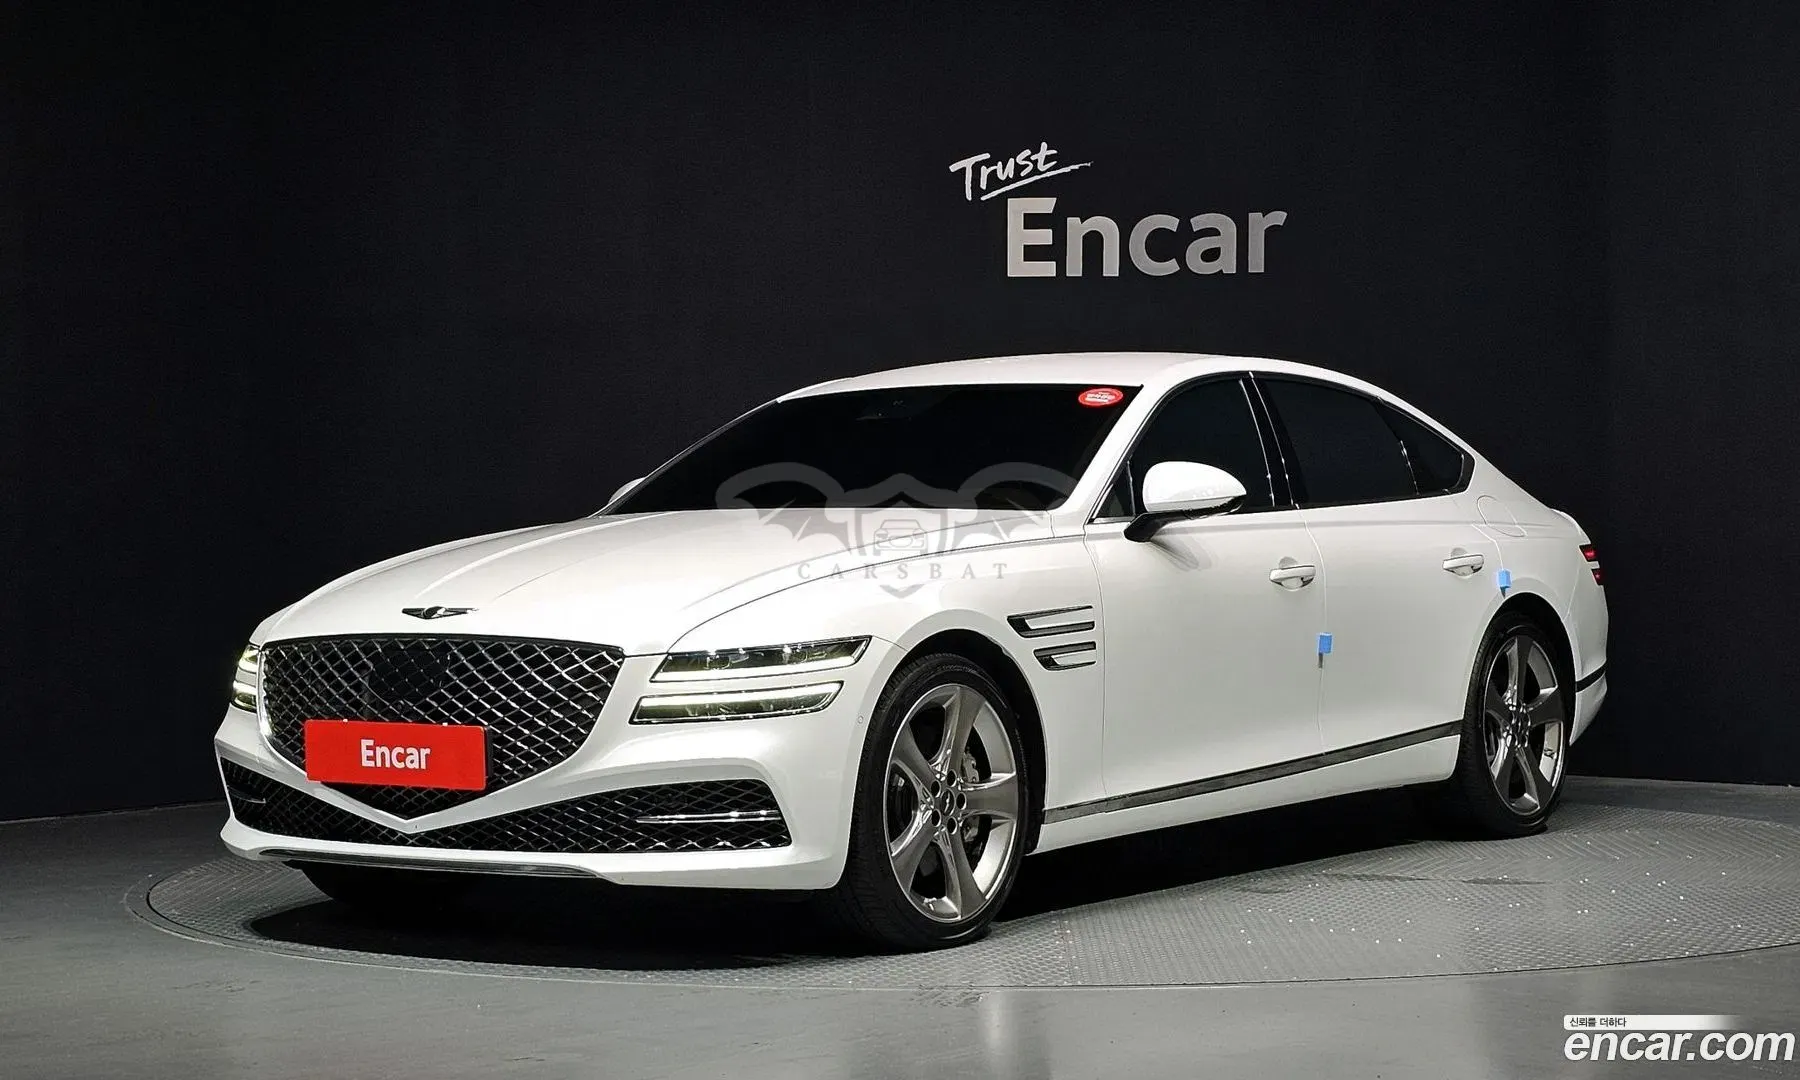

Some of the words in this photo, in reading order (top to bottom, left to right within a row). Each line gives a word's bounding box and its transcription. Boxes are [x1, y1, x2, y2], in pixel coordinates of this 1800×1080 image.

[949, 142, 1057, 200] Trust
[1007, 197, 1287, 277] Encar
[360, 739, 431, 769] Encar
